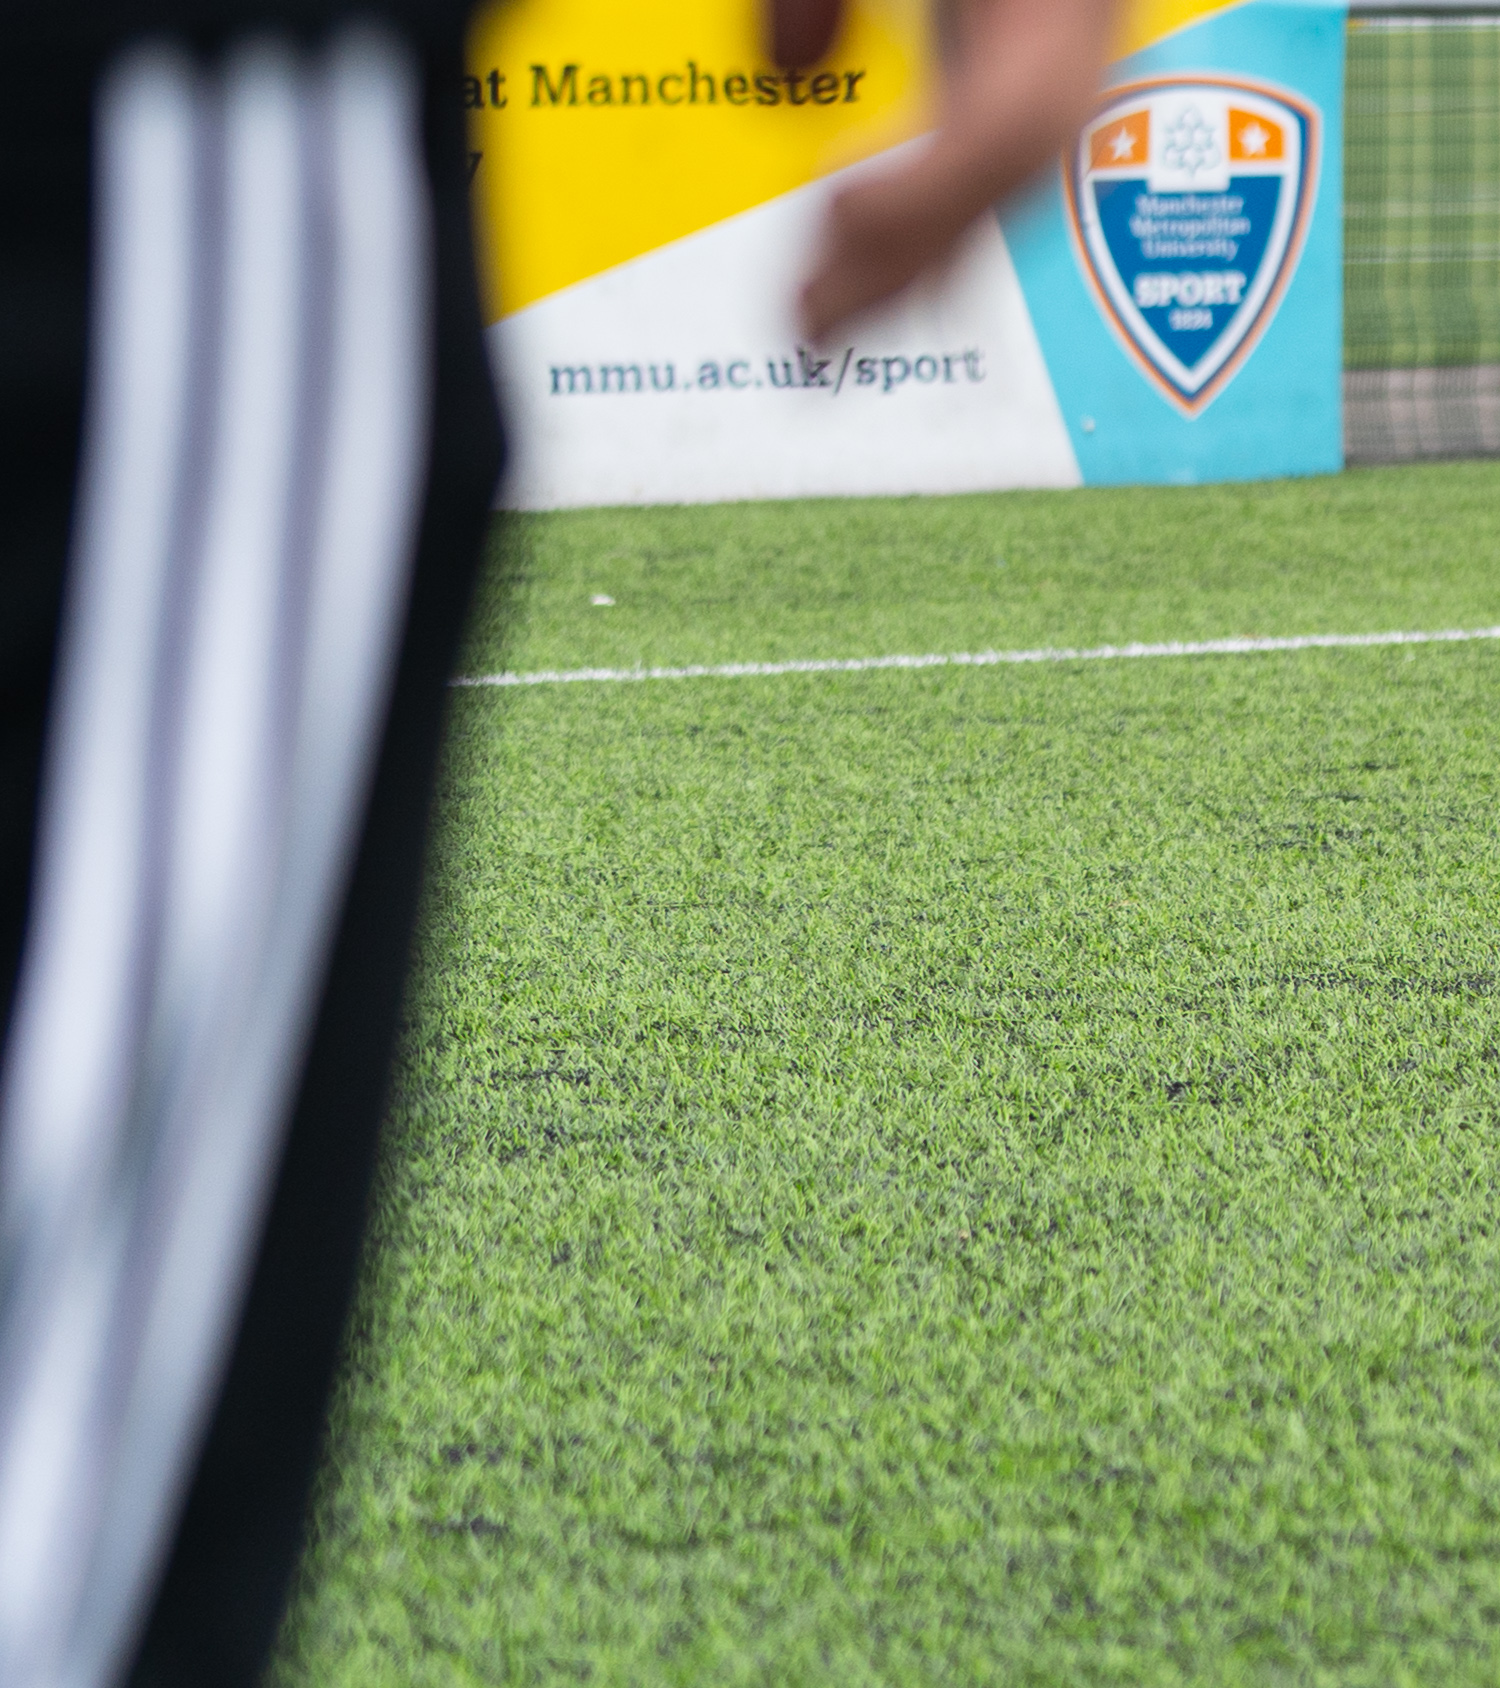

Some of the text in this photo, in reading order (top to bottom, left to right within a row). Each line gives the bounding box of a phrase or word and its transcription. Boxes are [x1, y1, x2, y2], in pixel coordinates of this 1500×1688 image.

[463, 61, 867, 110] at Manchester
[1135, 194, 1245, 214] Manchester
[1129, 216, 1251, 238] Metropolitan
[1140, 239, 1239, 261] University
[1134, 272, 1247, 307] SPORT
[549, 345, 988, 397] mmu.ac.uk/sport
